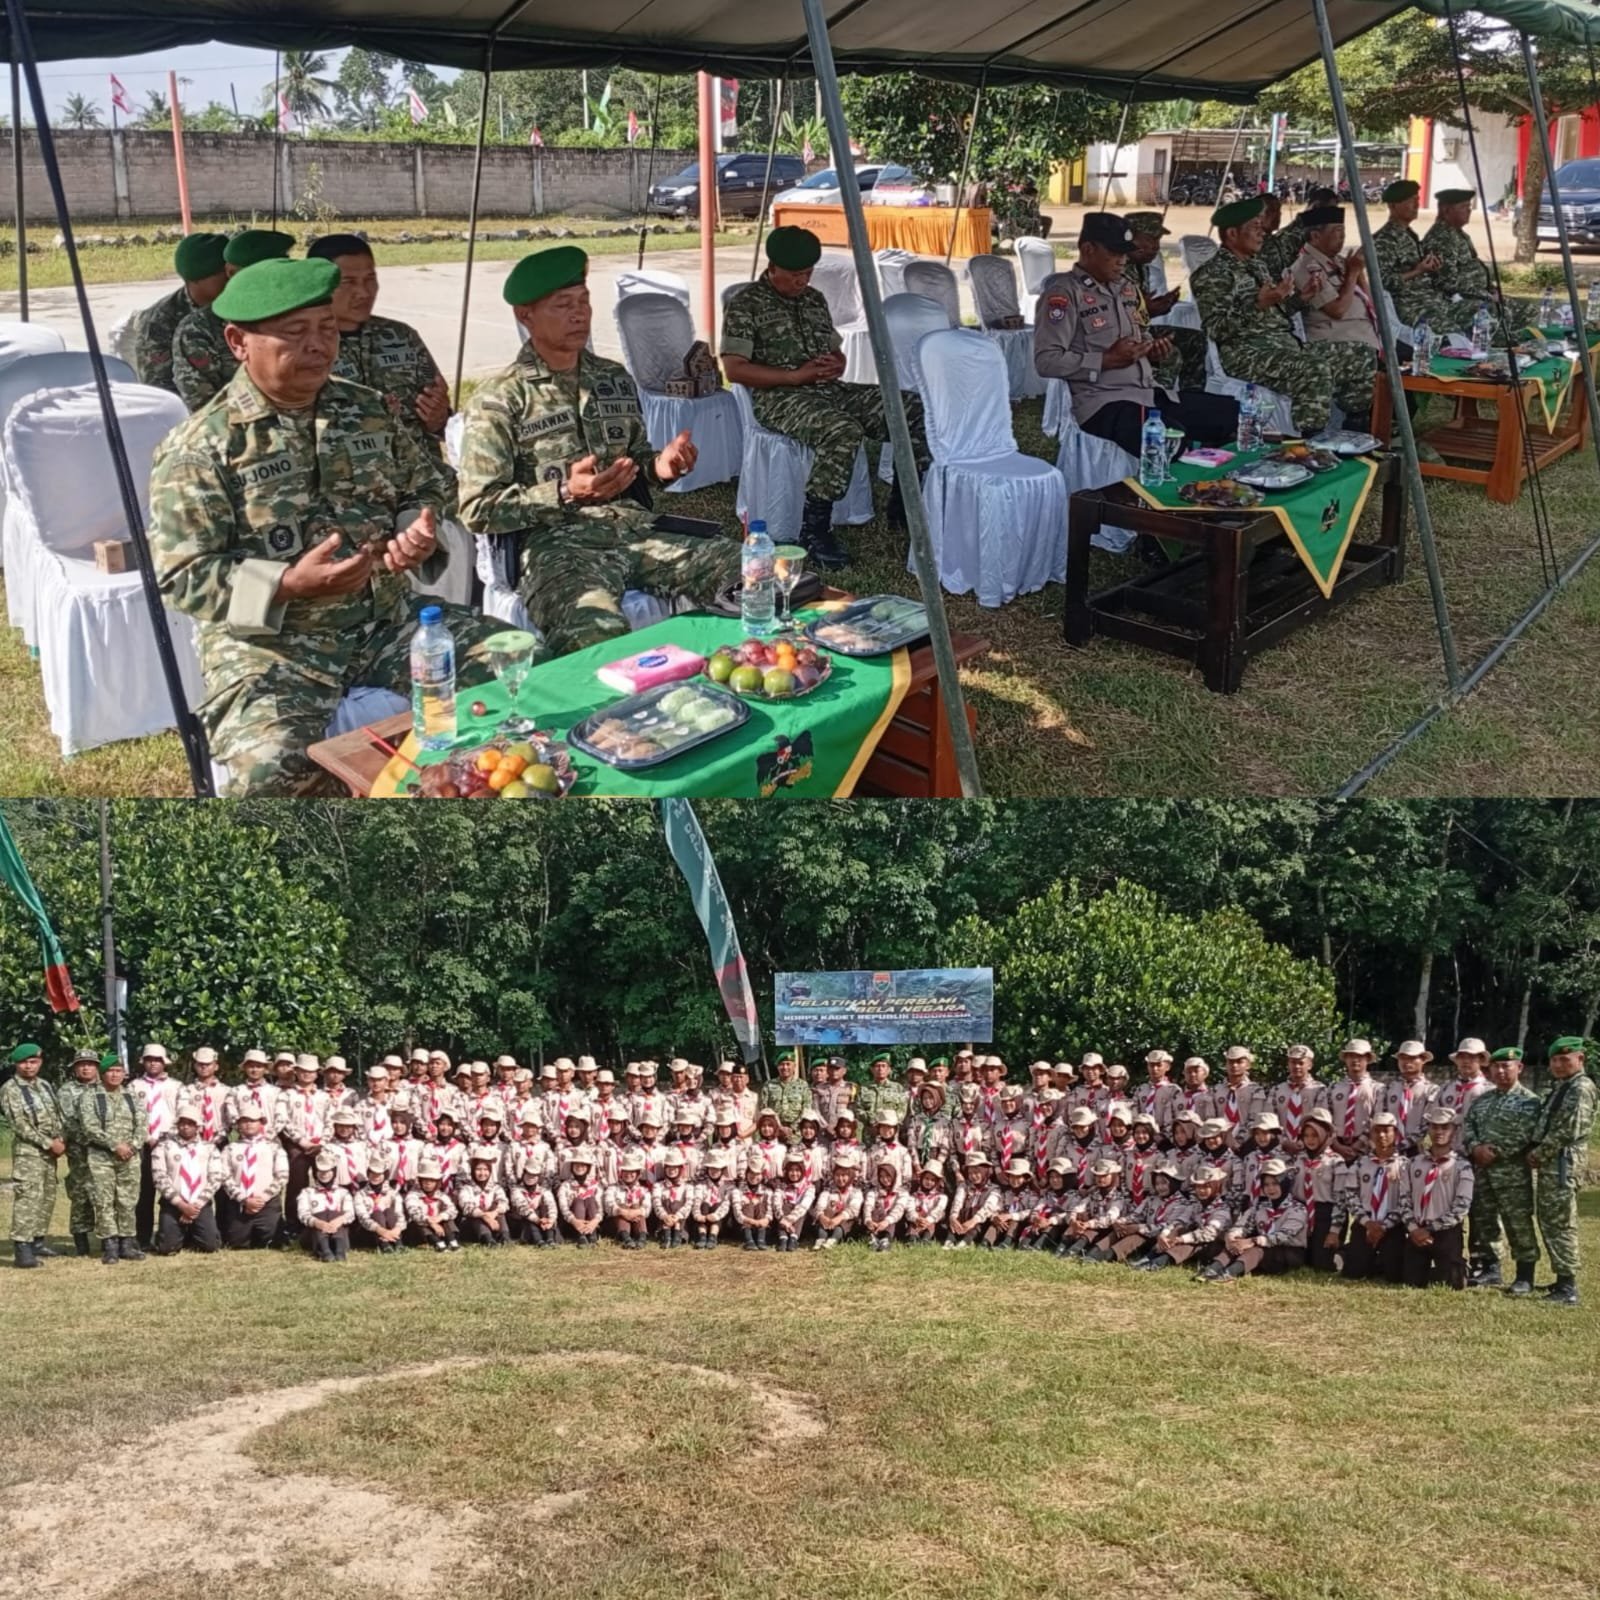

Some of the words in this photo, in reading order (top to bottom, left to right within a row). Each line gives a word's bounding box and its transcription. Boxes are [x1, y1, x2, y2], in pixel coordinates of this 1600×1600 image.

[1080, 306, 1099, 318] EKO
[381, 354, 400, 364] TNI
[604, 404, 622, 414] TNI
[521, 412, 570, 437] GUNAWAN
[352, 438, 377, 450] TNI
[790, 998, 880, 1008] PELATIHAN
[883, 996, 957, 1007] PERSAMI
[855, 1006, 896, 1014] BELA
[900, 1003, 967, 1013] NEGARA
[784, 1013, 818, 1021] KORPS
[820, 1013, 855, 1021] KADET
[857, 1013, 911, 1021] REPUBLIK
